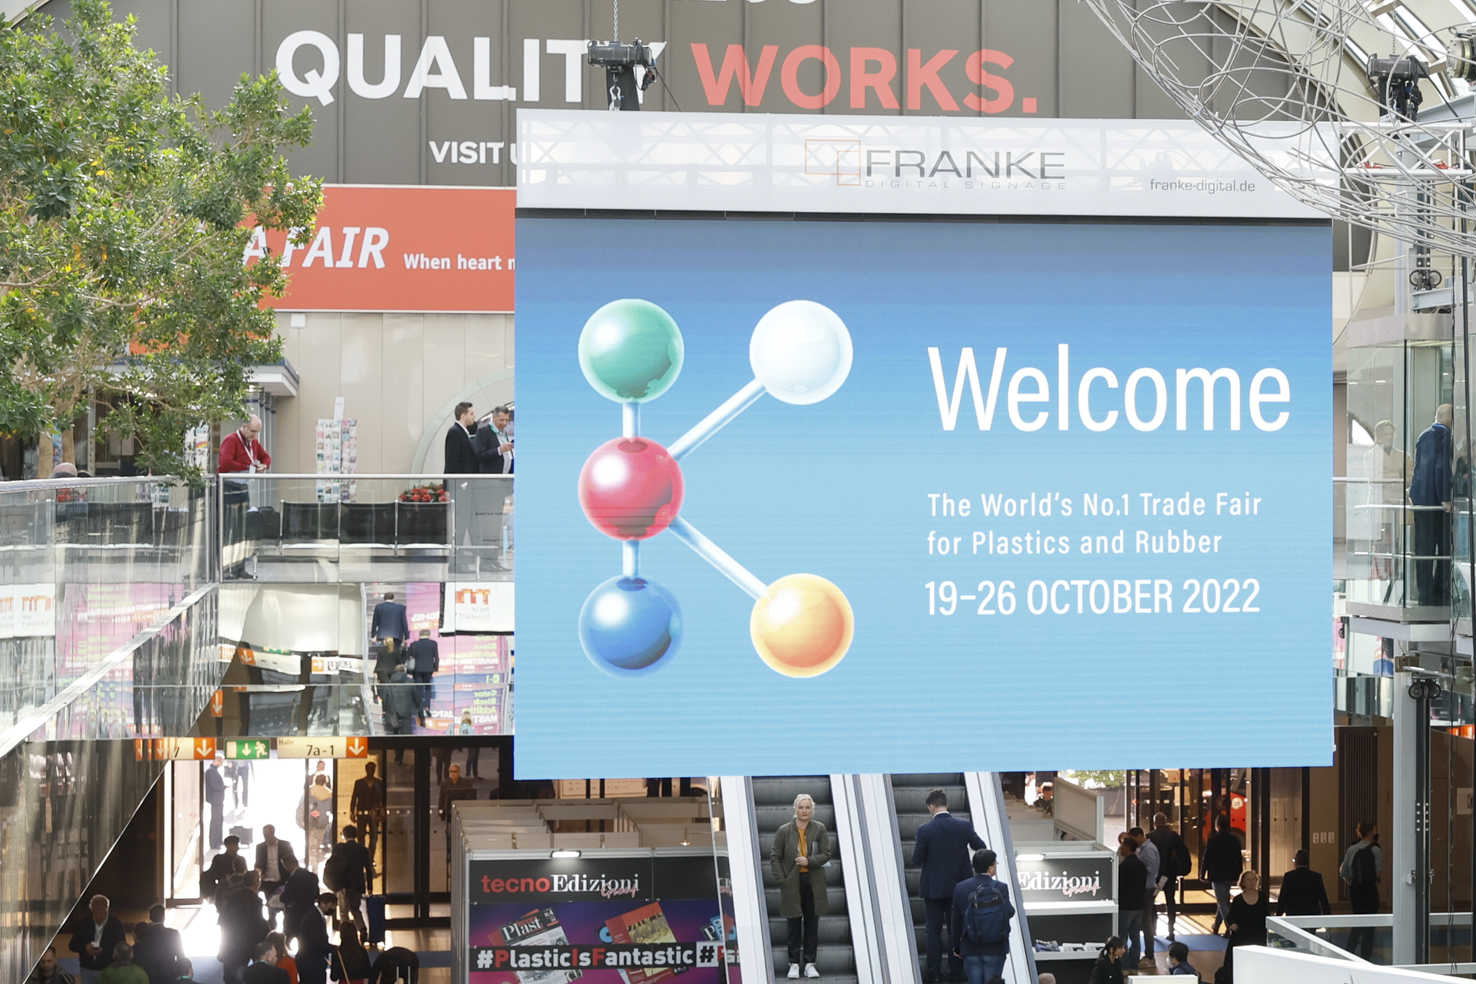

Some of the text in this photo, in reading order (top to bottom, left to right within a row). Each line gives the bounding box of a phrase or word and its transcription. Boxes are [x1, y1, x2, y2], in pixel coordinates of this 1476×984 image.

[690, 43, 1037, 113] WORKS.
[429, 141, 504, 164] VISIT
[866, 150, 1066, 180] FRANKE
[1150, 178, 1256, 194] franke-digital.de
[404, 253, 451, 270] When
[457, 253, 502, 271] heart
[927, 343, 1291, 432] Welcome
[927, 491, 1262, 517] The World's No.1 Trade Fair
[927, 529, 1223, 555] for Plastics and Rubber
[1027, 579, 1173, 615] OCTOBER
[1182, 578, 1261, 613] 2022
[477, 946, 693, 969] #PlasticIsFantastic
